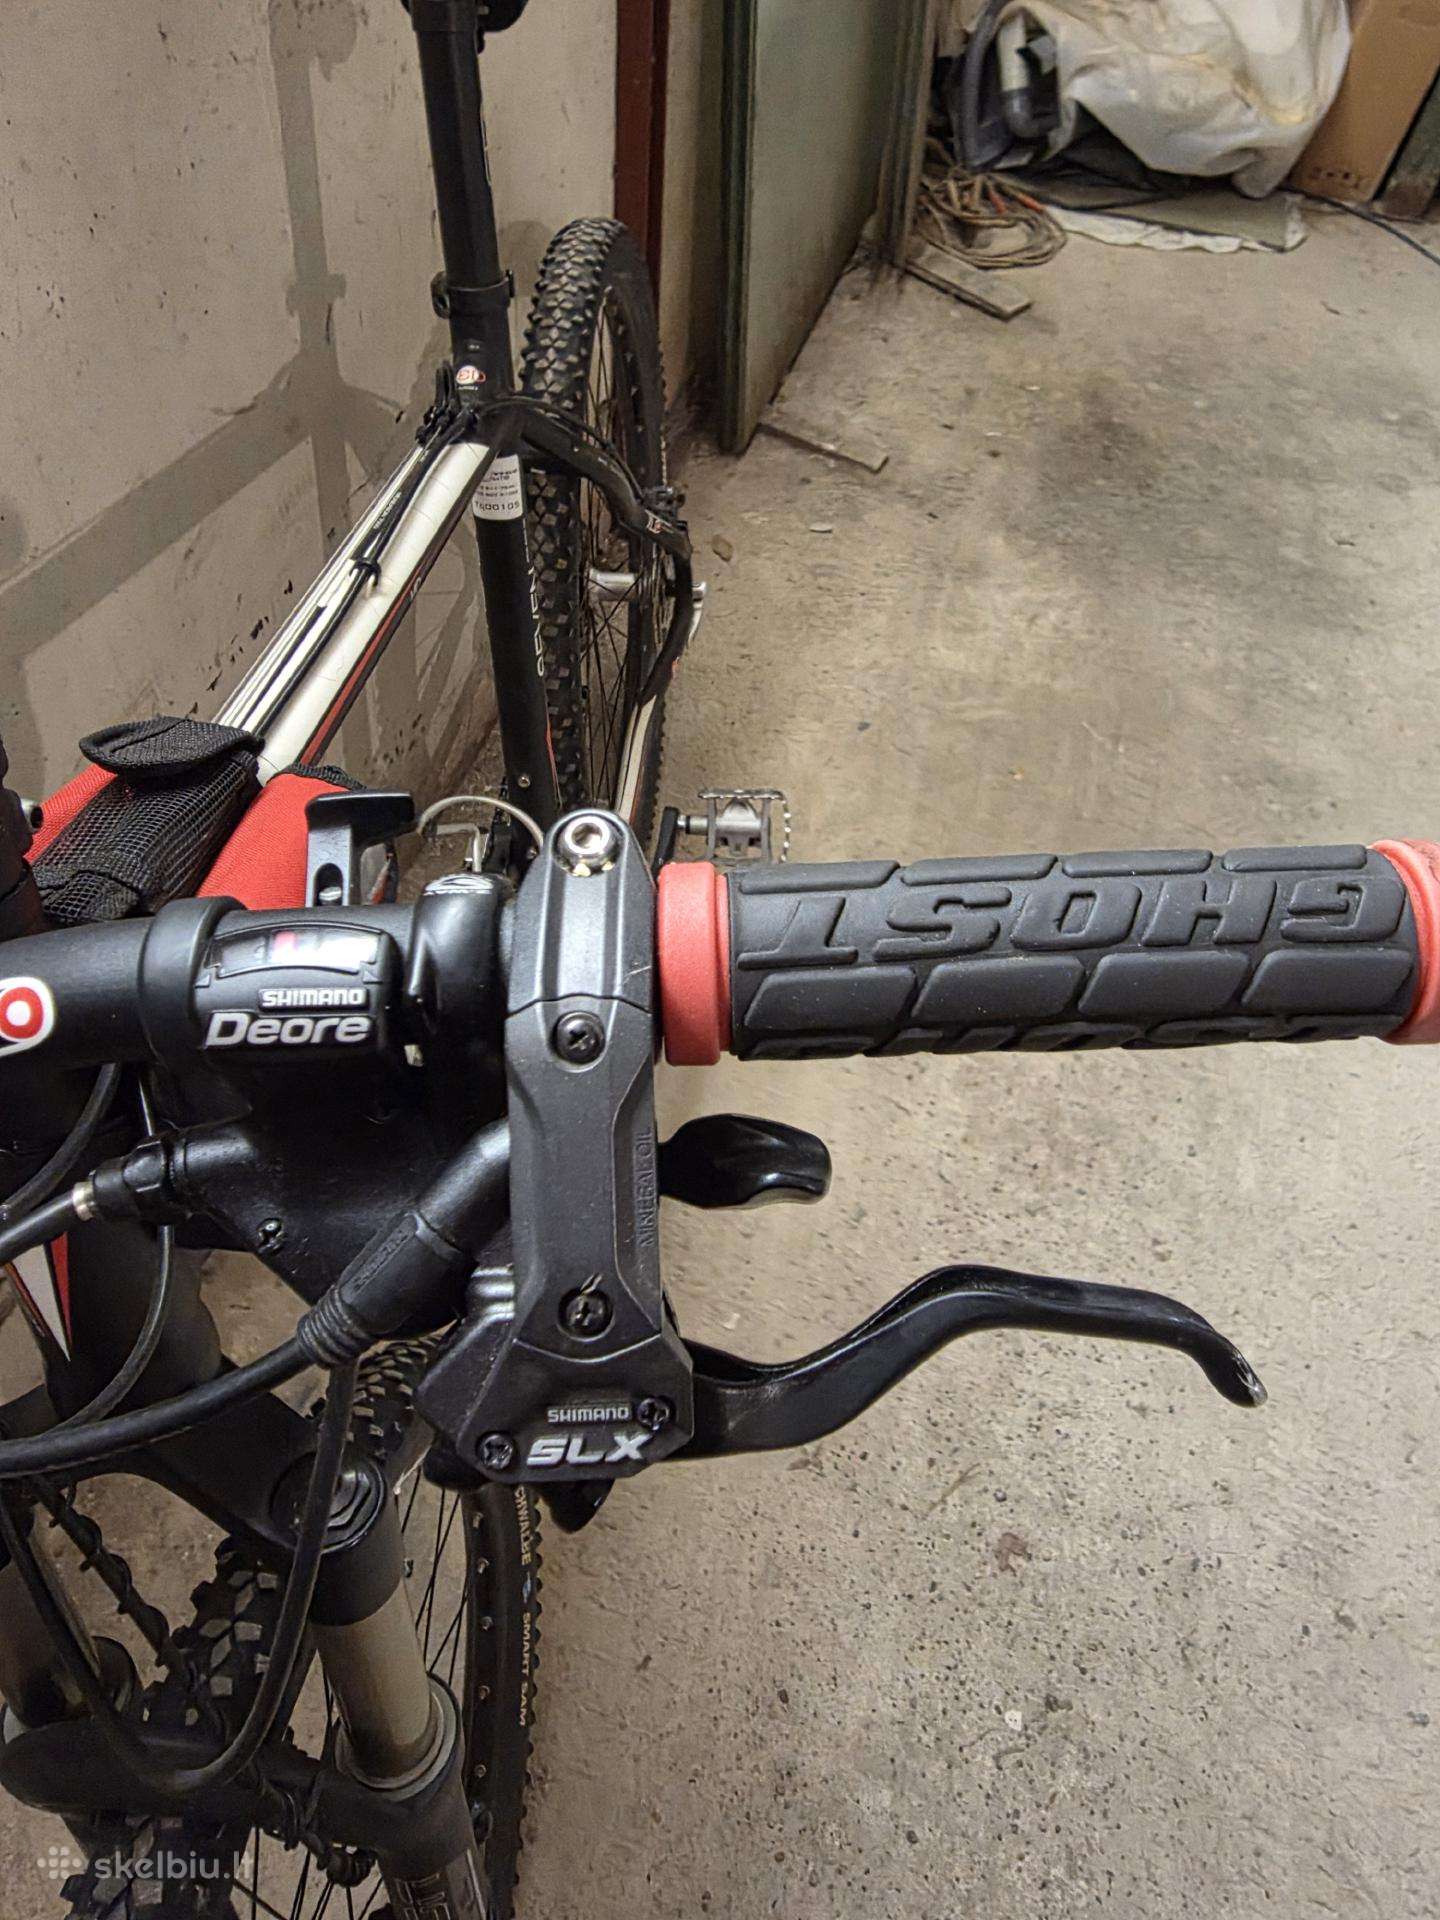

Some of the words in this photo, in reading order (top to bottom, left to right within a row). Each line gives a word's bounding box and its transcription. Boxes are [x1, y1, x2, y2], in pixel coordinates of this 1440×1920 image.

[738, 876, 1406, 969] GHOST
[262, 989, 365, 1007] SHIMANO
[204, 1010, 372, 1050] Deore
[547, 1406, 631, 1423] SHIMANO
[526, 1433, 653, 1466] SLX
[521, 1612, 531, 1677] SMART
[519, 1682, 529, 1726] SAM
